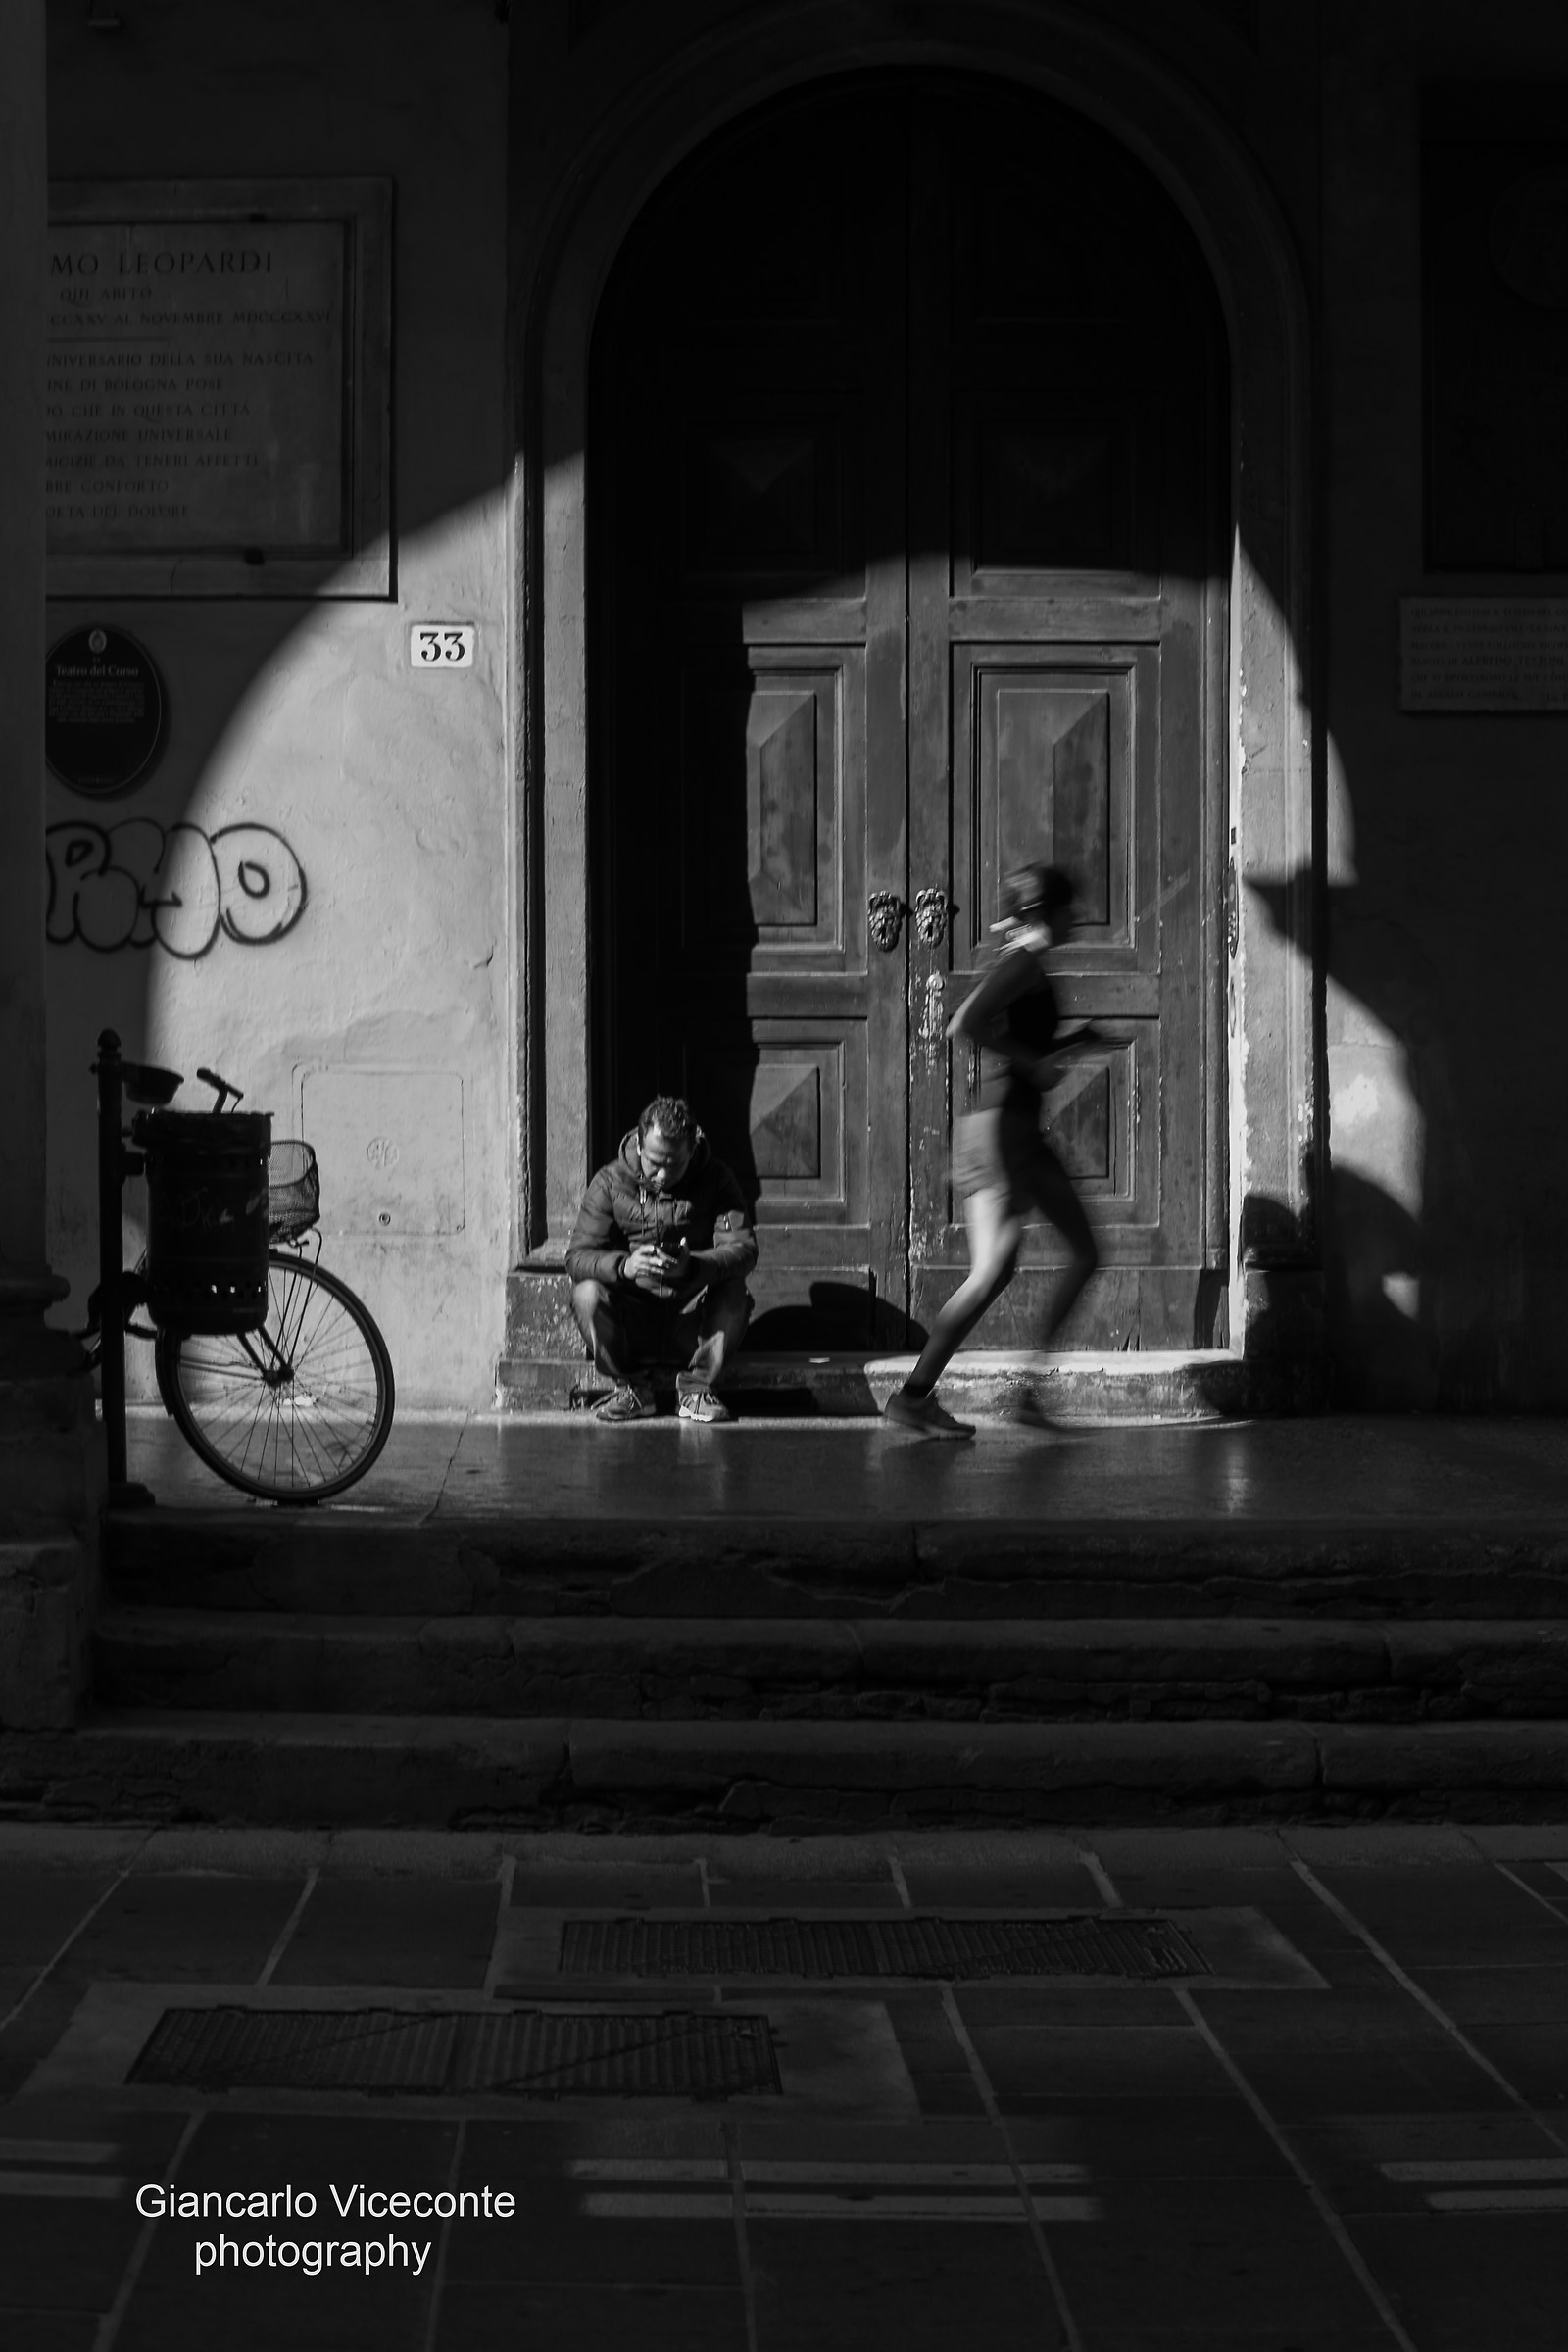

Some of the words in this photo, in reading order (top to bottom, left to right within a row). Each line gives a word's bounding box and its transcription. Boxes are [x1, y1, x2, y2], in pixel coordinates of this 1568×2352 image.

[50, 251, 99, 277] MO
[118, 249, 272, 276] LEOPARDI
[60, 287, 92, 306] QUI
[114, 312, 131, 326] AL
[140, 311, 222, 326] NOVEMBRE
[233, 309, 331, 325] MDCCCXXVI
[150, 352, 196, 368] DELLA
[204, 352, 234, 367] SUA
[242, 351, 314, 367] NASCITA
[80, 377, 97, 393] DI
[104, 377, 179, 393] BOLOGNA
[186, 377, 223, 392] POSE
[71, 403, 104, 417] CHE
[110, 403, 126, 417] IN
[133, 403, 194, 422] QUESTA
[137, 427, 232, 443] UNIVERSALE
[105, 453, 126, 469] DA
[134, 453, 188, 468] TENERI
[195, 452, 258, 467] AFFETTI
[80, 477, 170, 494] CONFORTO
[92, 504, 119, 519] DEL
[128, 503, 189, 519] DOLORE
[419, 632, 466, 662] 33
[1461, 656, 1512, 667] ALFREDO
[55, 663, 88, 678] Teatro
[89, 663, 106, 678] del
[108, 663, 139, 678] Corso
